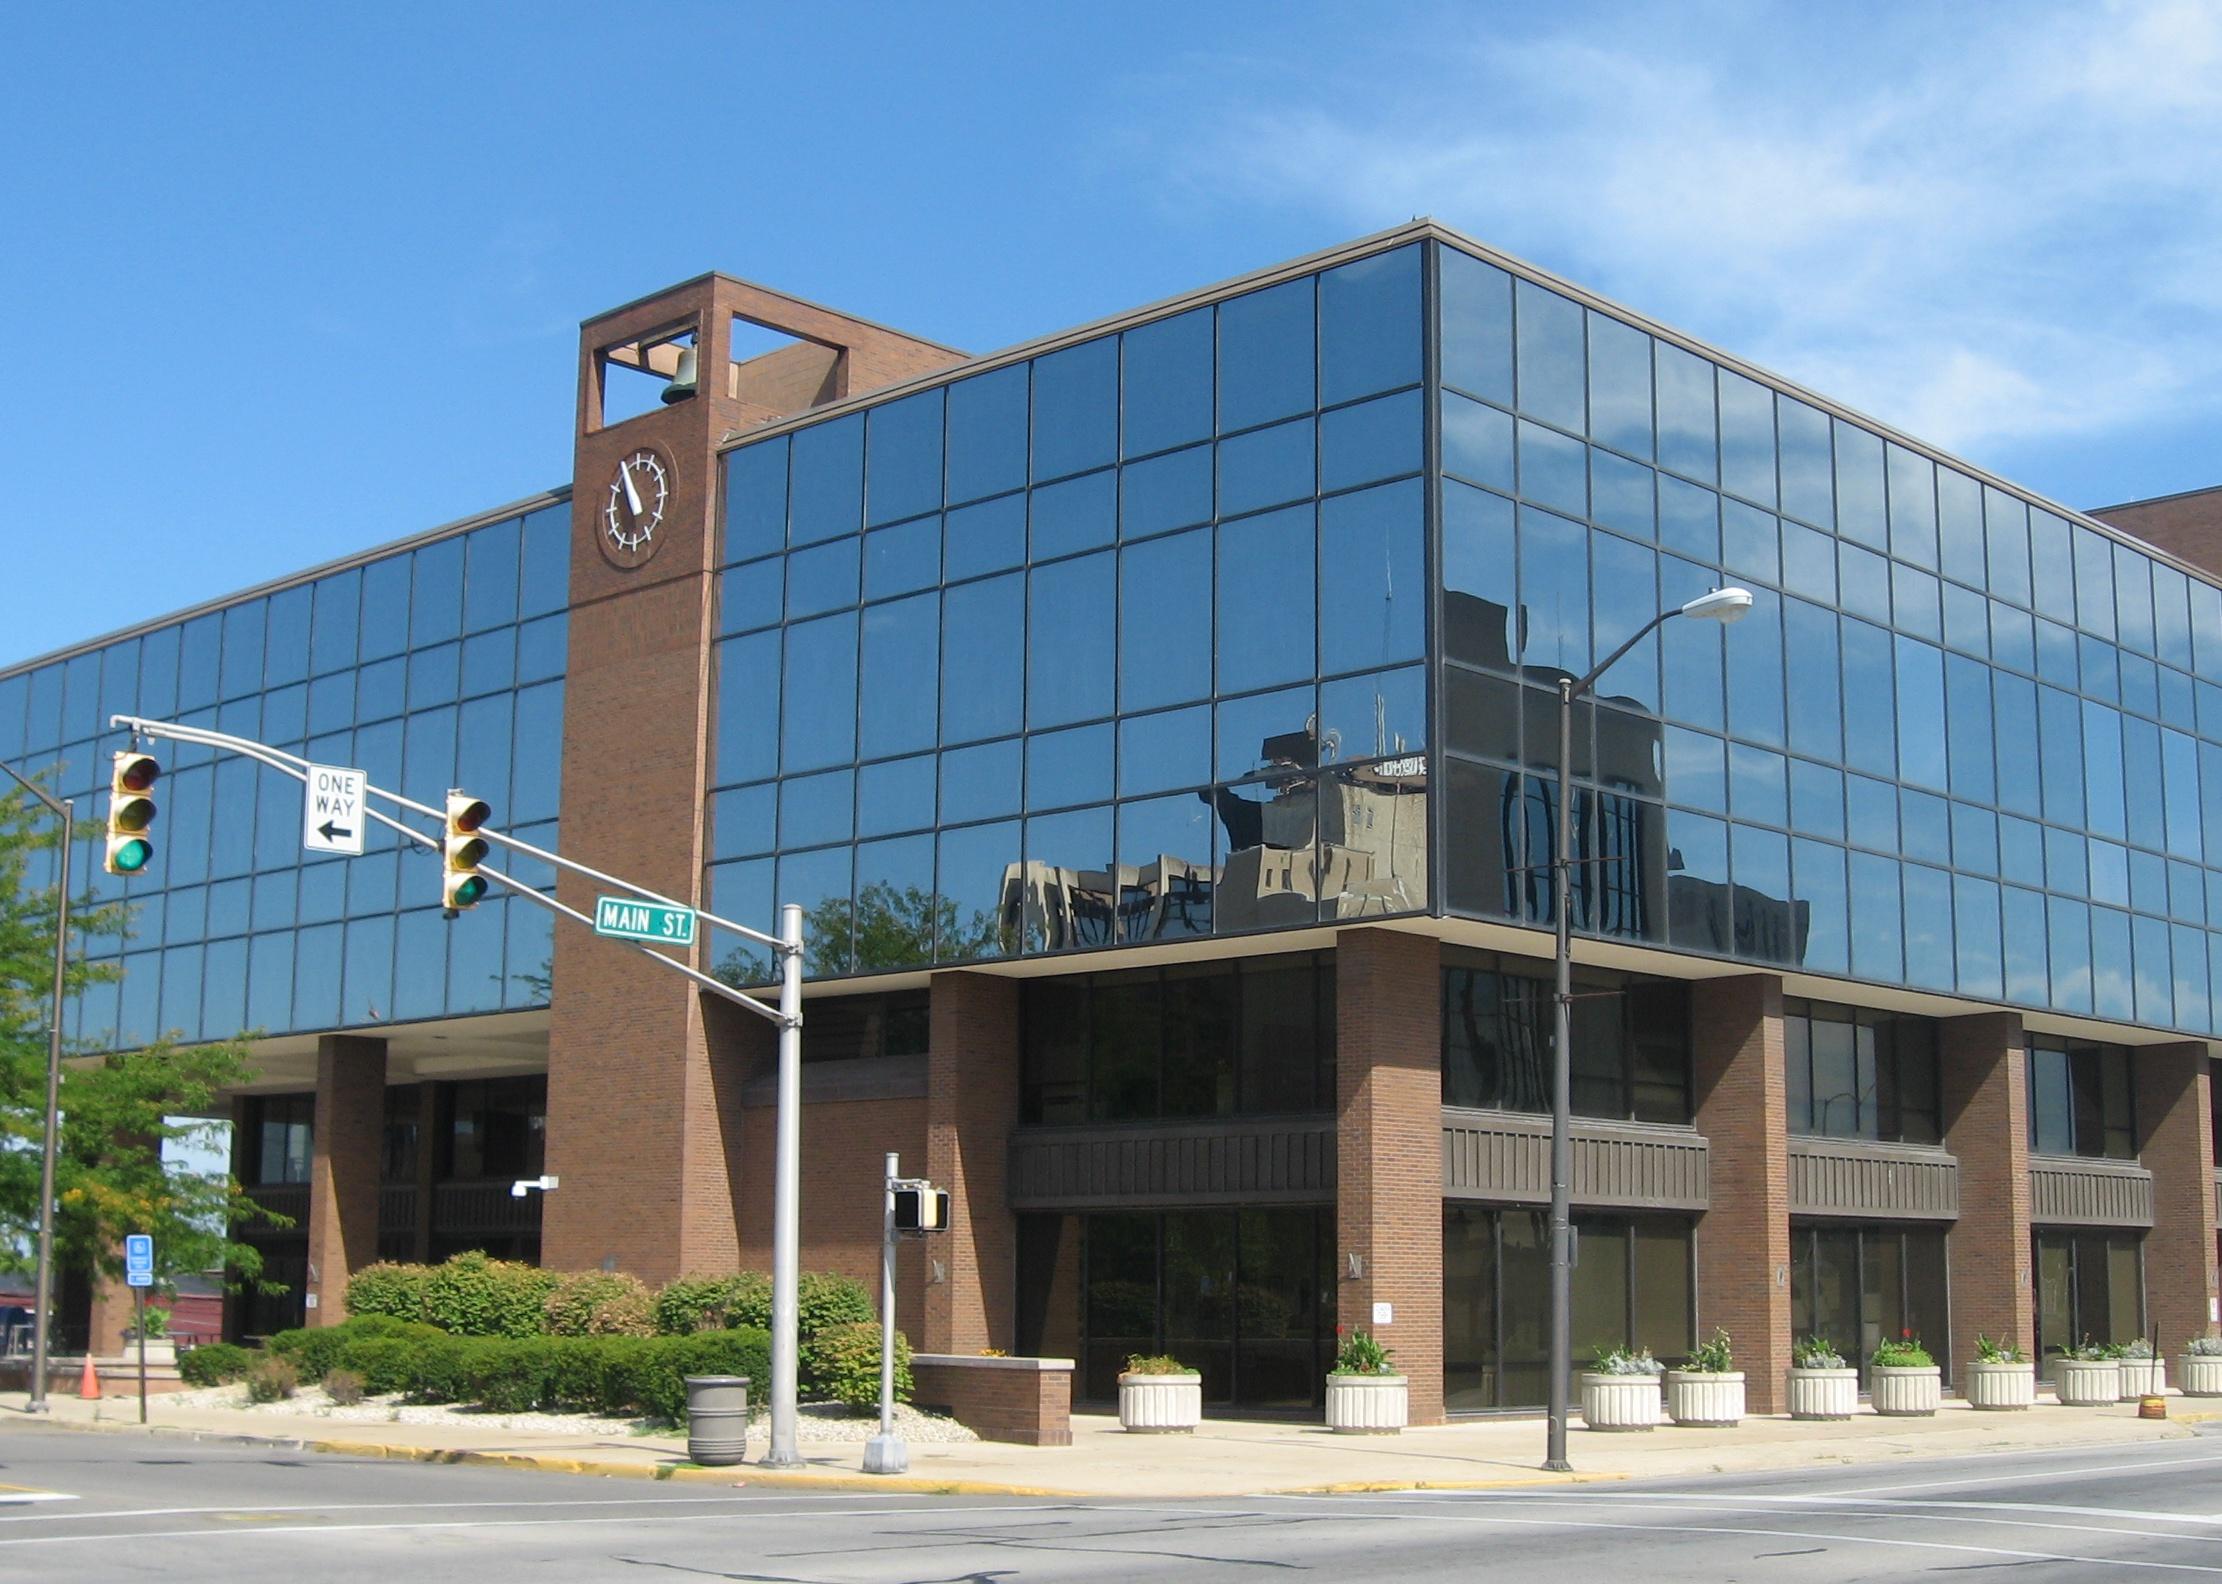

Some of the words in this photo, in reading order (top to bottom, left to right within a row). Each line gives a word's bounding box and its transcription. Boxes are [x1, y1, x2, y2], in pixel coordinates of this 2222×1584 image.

[318, 773, 355, 795] ONE
[316, 795, 355, 817] WAY
[603, 903, 650, 932] MAIN
[663, 912, 687, 937] ST.
